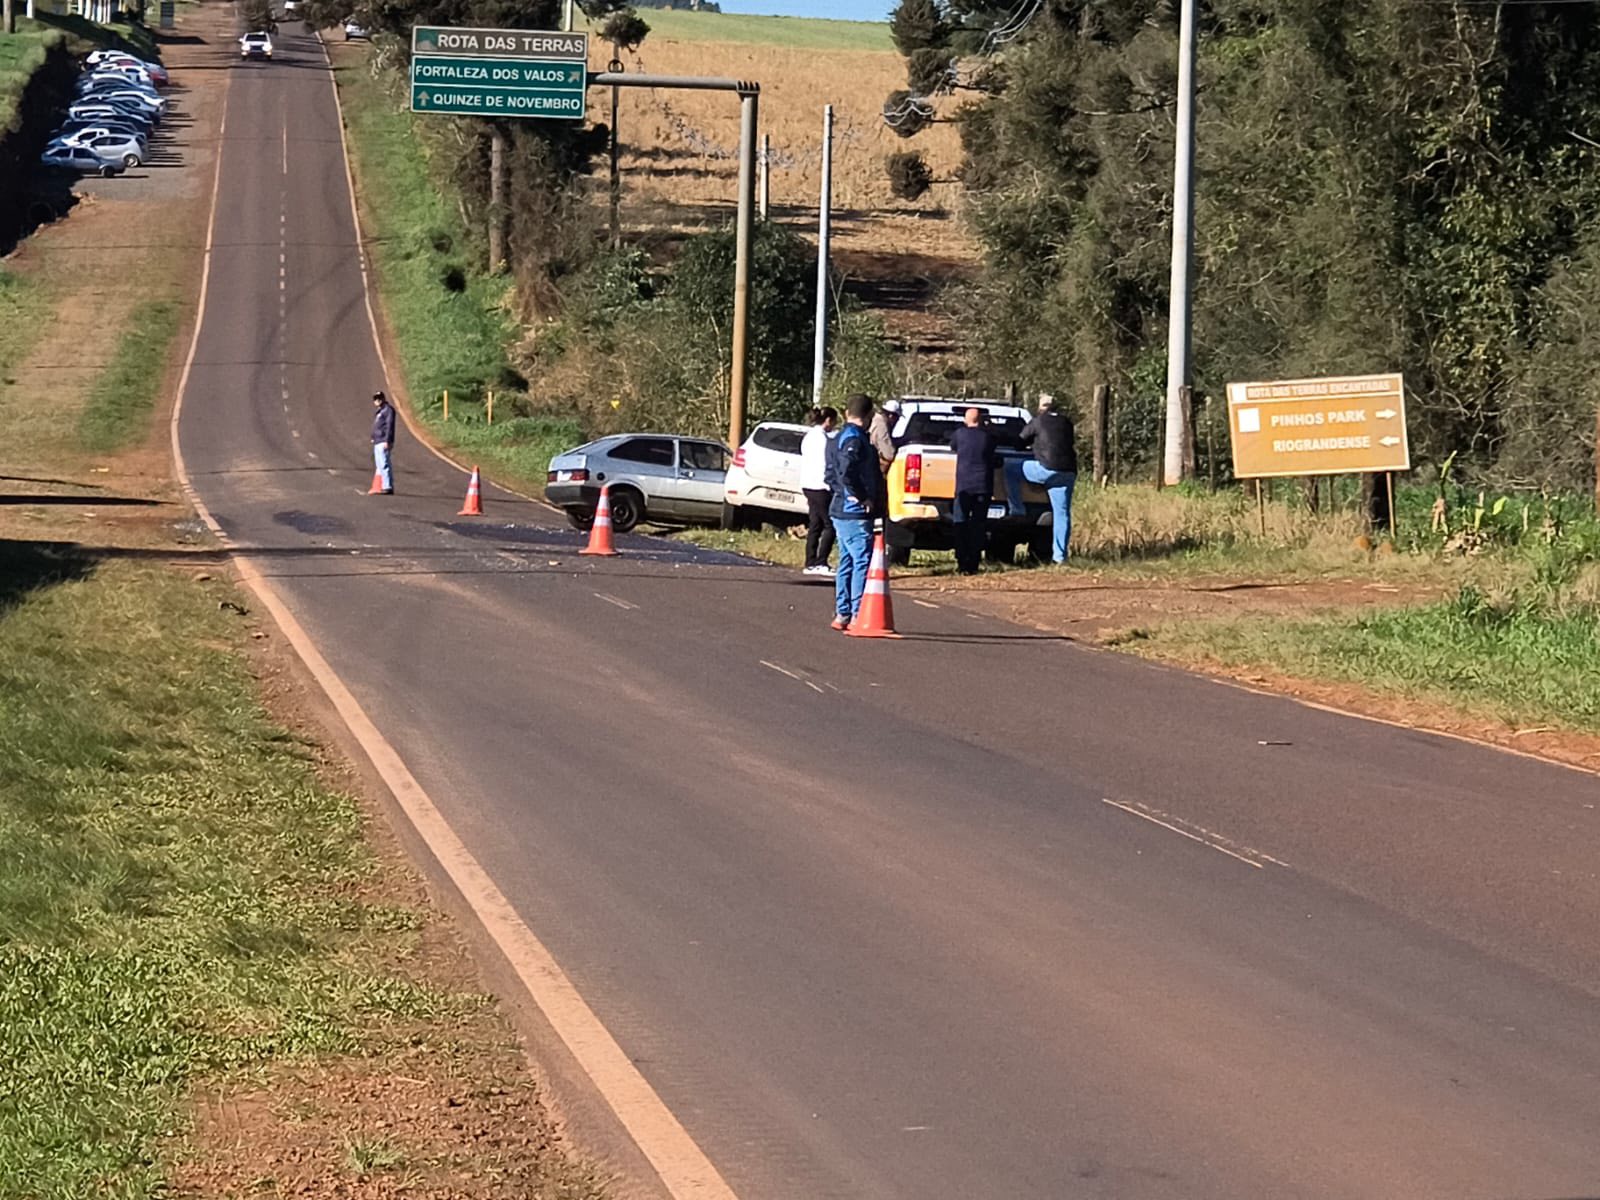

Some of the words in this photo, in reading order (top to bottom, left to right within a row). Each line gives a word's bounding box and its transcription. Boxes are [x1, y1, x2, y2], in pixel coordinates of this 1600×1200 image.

[438, 34, 479, 49] ROTA
[485, 36, 516, 50] DAS
[522, 37, 584, 53] TERRAS
[415, 65, 488, 79] FORTALEZA
[493, 68, 519, 80] DOS
[524, 70, 565, 82] VALOS
[433, 93, 482, 106] QUINZE
[485, 95, 503, 107] DE
[507, 96, 581, 110] NOVEMBRO
[1271, 412, 1324, 427] PINHOS
[1328, 409, 1367, 423] PARK
[1273, 435, 1371, 452] RIOGRANDENSE
